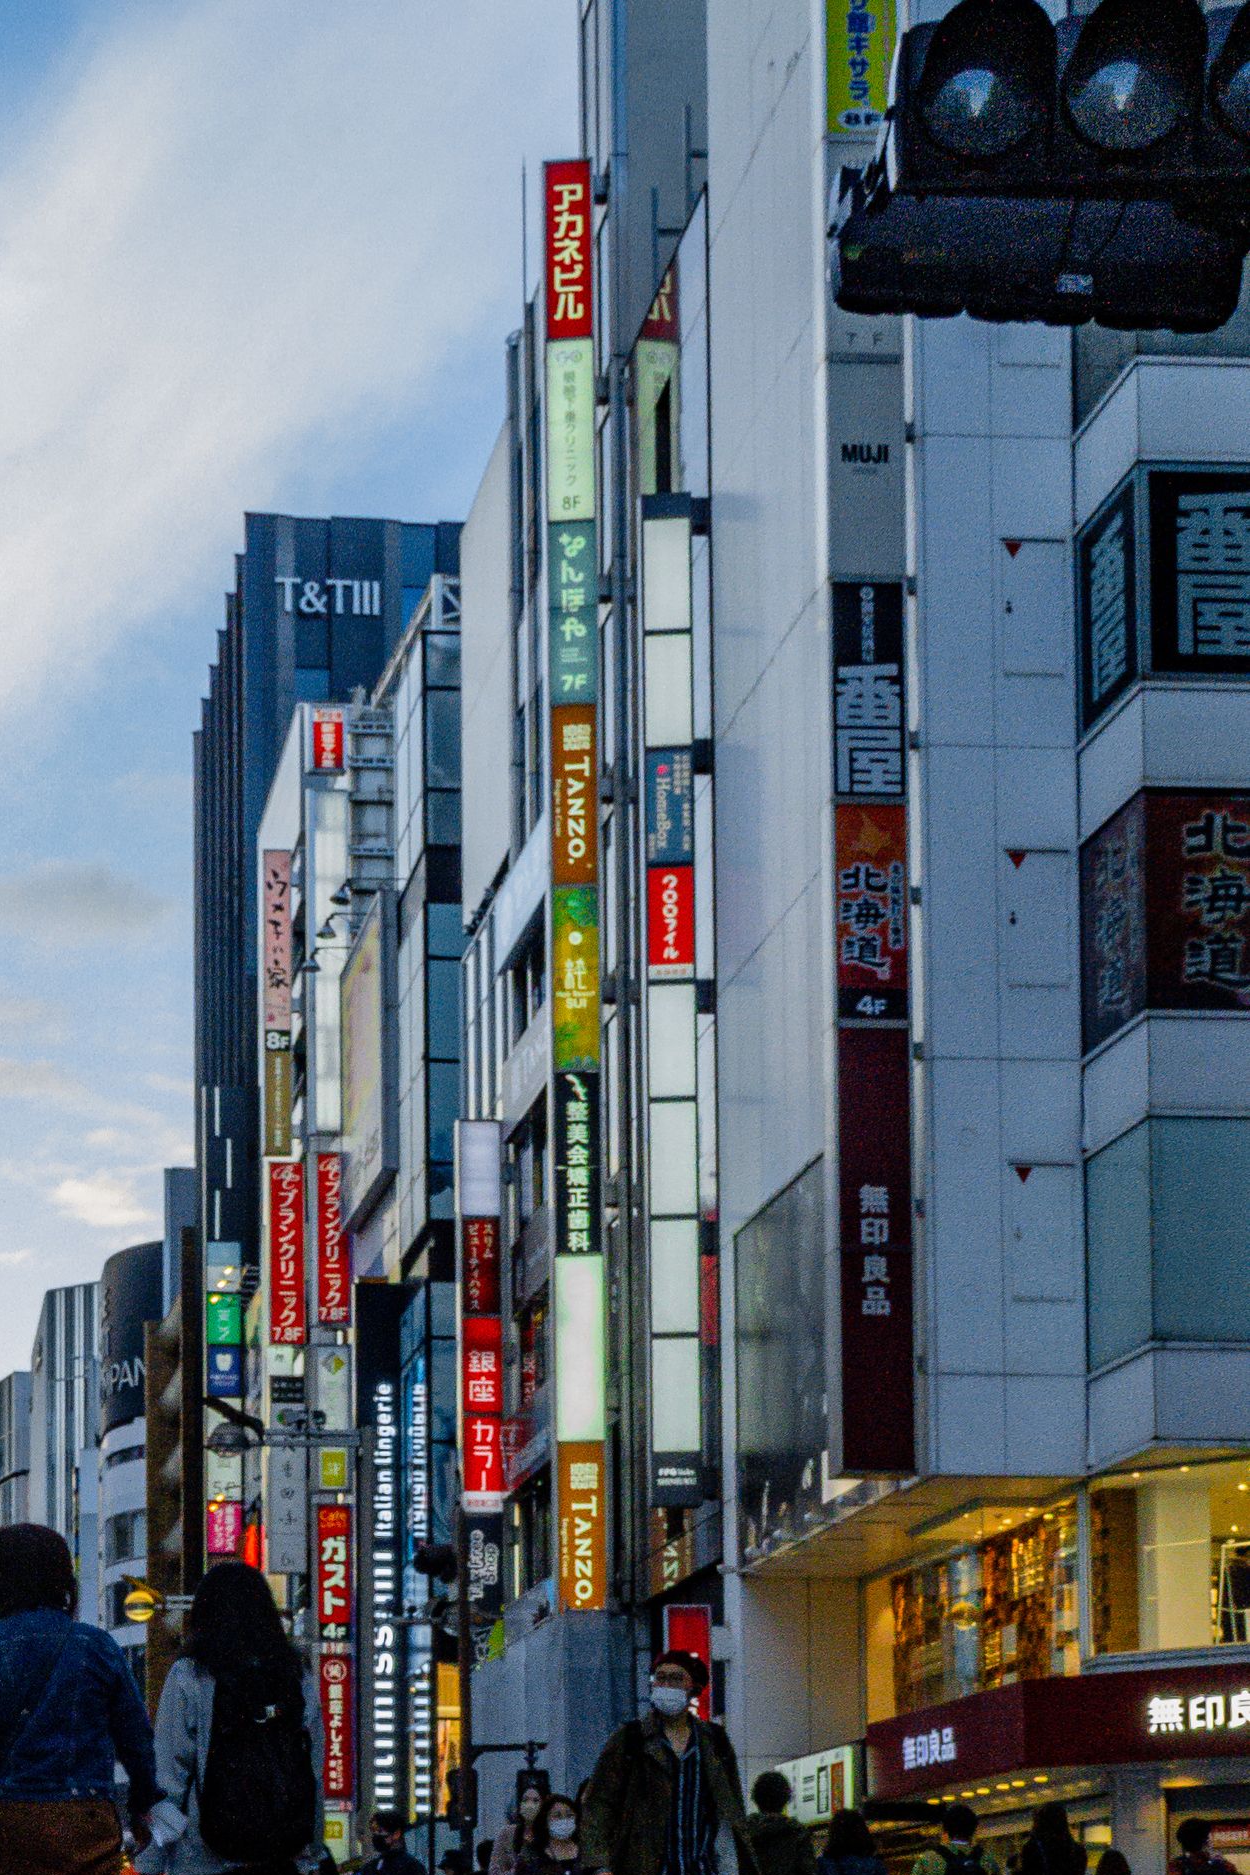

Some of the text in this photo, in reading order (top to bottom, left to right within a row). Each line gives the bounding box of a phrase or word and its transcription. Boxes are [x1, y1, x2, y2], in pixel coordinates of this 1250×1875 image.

[553, 183, 584, 321] アカネビル
[841, 443, 889, 463] MUJI
[562, 496, 581, 511] 8F
[560, 673, 588, 693] 7F
[564, 755, 591, 865] TANZO.
[841, 863, 890, 970] 北海道
[266, 1032, 290, 1050] 8F
[856, 996, 887, 1015] 4F
[860, 1185, 891, 1317] 無印良品
[373, 1382, 396, 1465] lingerie
[468, 1350, 498, 1492] 銀座カラー
[321, 1535, 347, 1616] ガスト
[571, 1495, 598, 1605] TANZO.
[322, 1622, 347, 1639] 4F
[902, 1727, 957, 1770] 無印良品
